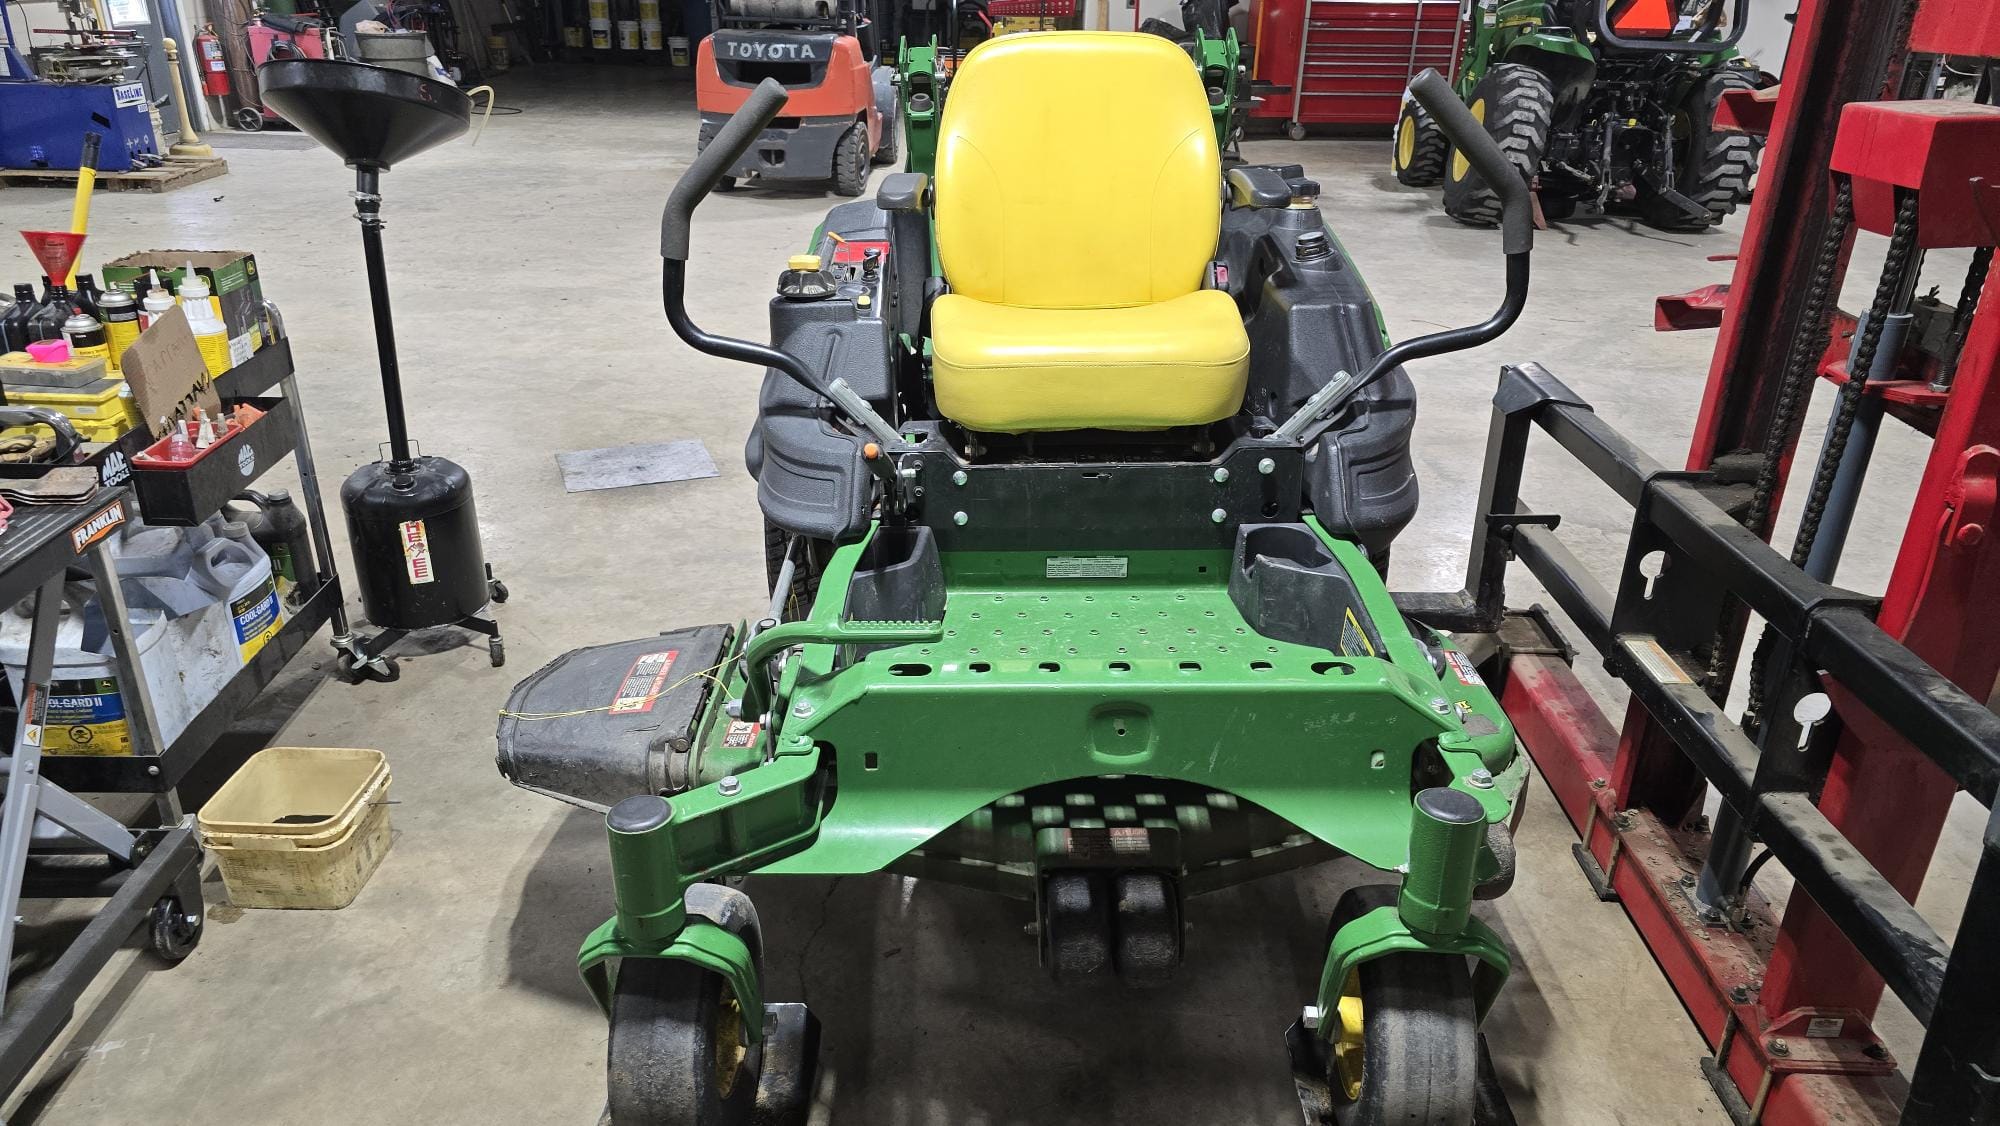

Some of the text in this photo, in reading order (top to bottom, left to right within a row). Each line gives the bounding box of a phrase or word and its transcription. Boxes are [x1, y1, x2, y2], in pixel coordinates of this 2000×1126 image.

[727, 41, 817, 59] TOYOTA
[102, 451, 127, 481] MAC
[75, 505, 124, 548] FRANKLIN
[240, 598, 271, 626] COOL-GARD
[94, 696, 102, 707] II
